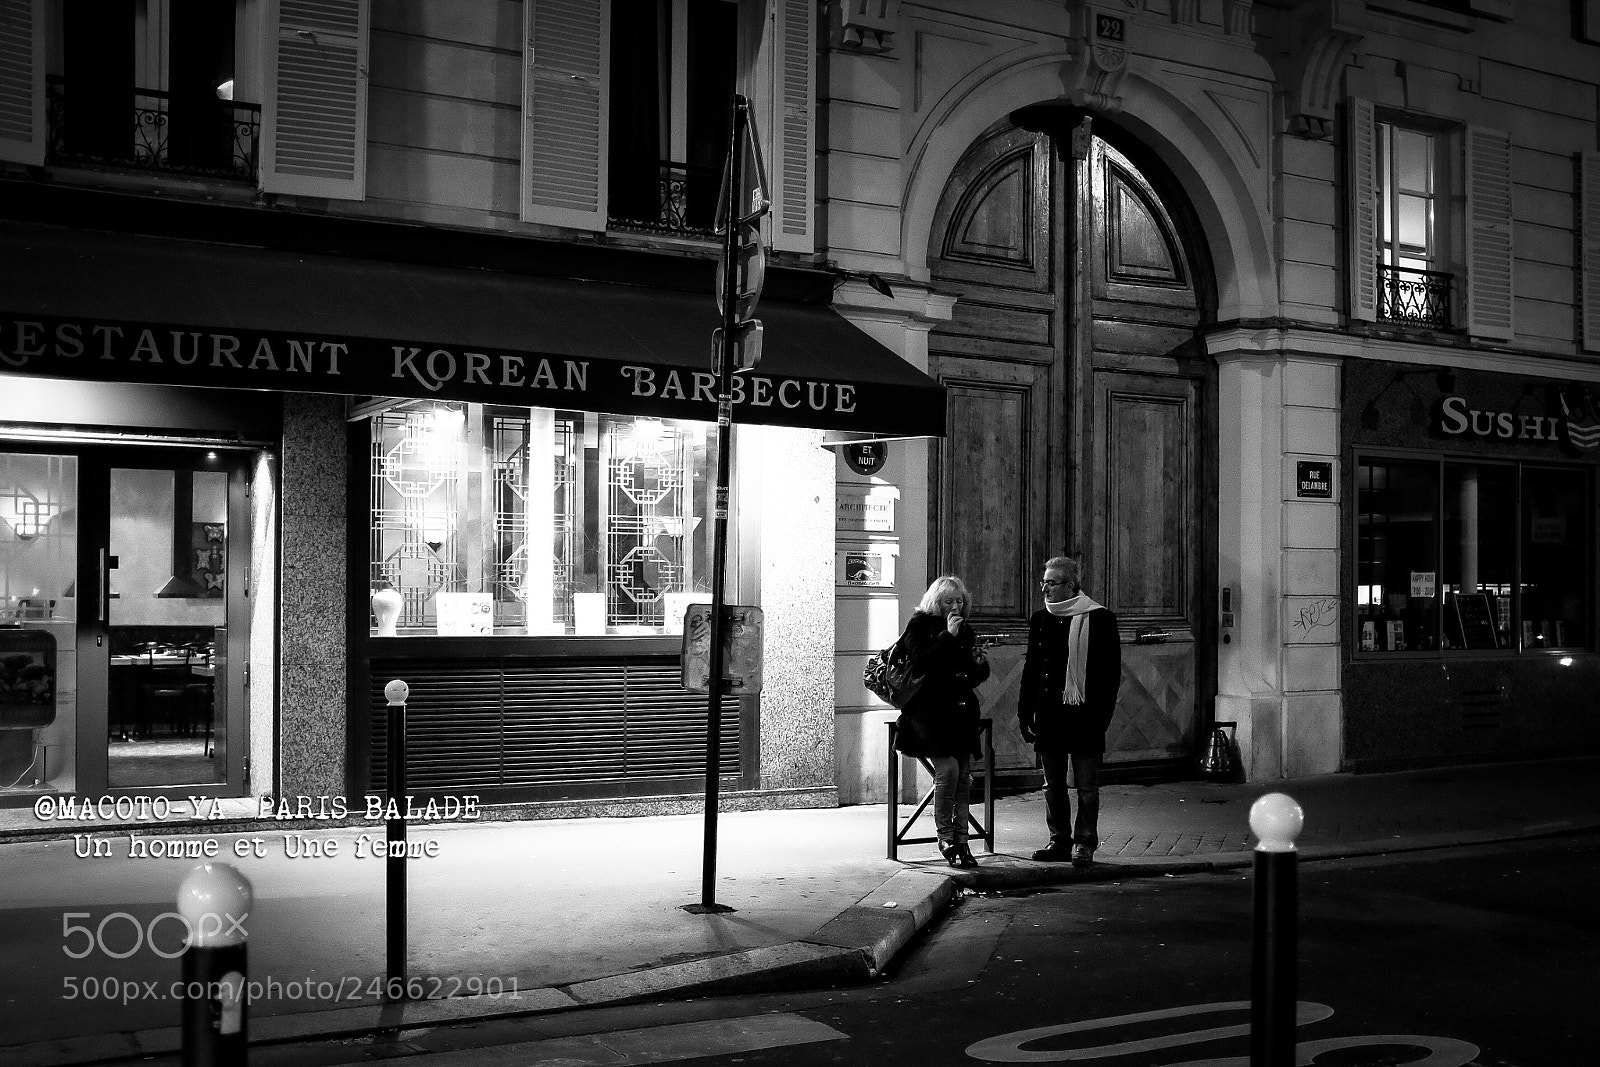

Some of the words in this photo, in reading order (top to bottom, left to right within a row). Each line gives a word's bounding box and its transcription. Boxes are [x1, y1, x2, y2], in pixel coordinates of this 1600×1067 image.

[1101, 18, 1120, 38] 22
[391, 346, 590, 391] KOREAN
[620, 365, 857, 413] BARBECUE
[1441, 396, 1559, 441] SUSHI
[862, 445, 873, 454] ET
[858, 456, 876, 466] NUIT
[1310, 470, 1320, 479] RUE
